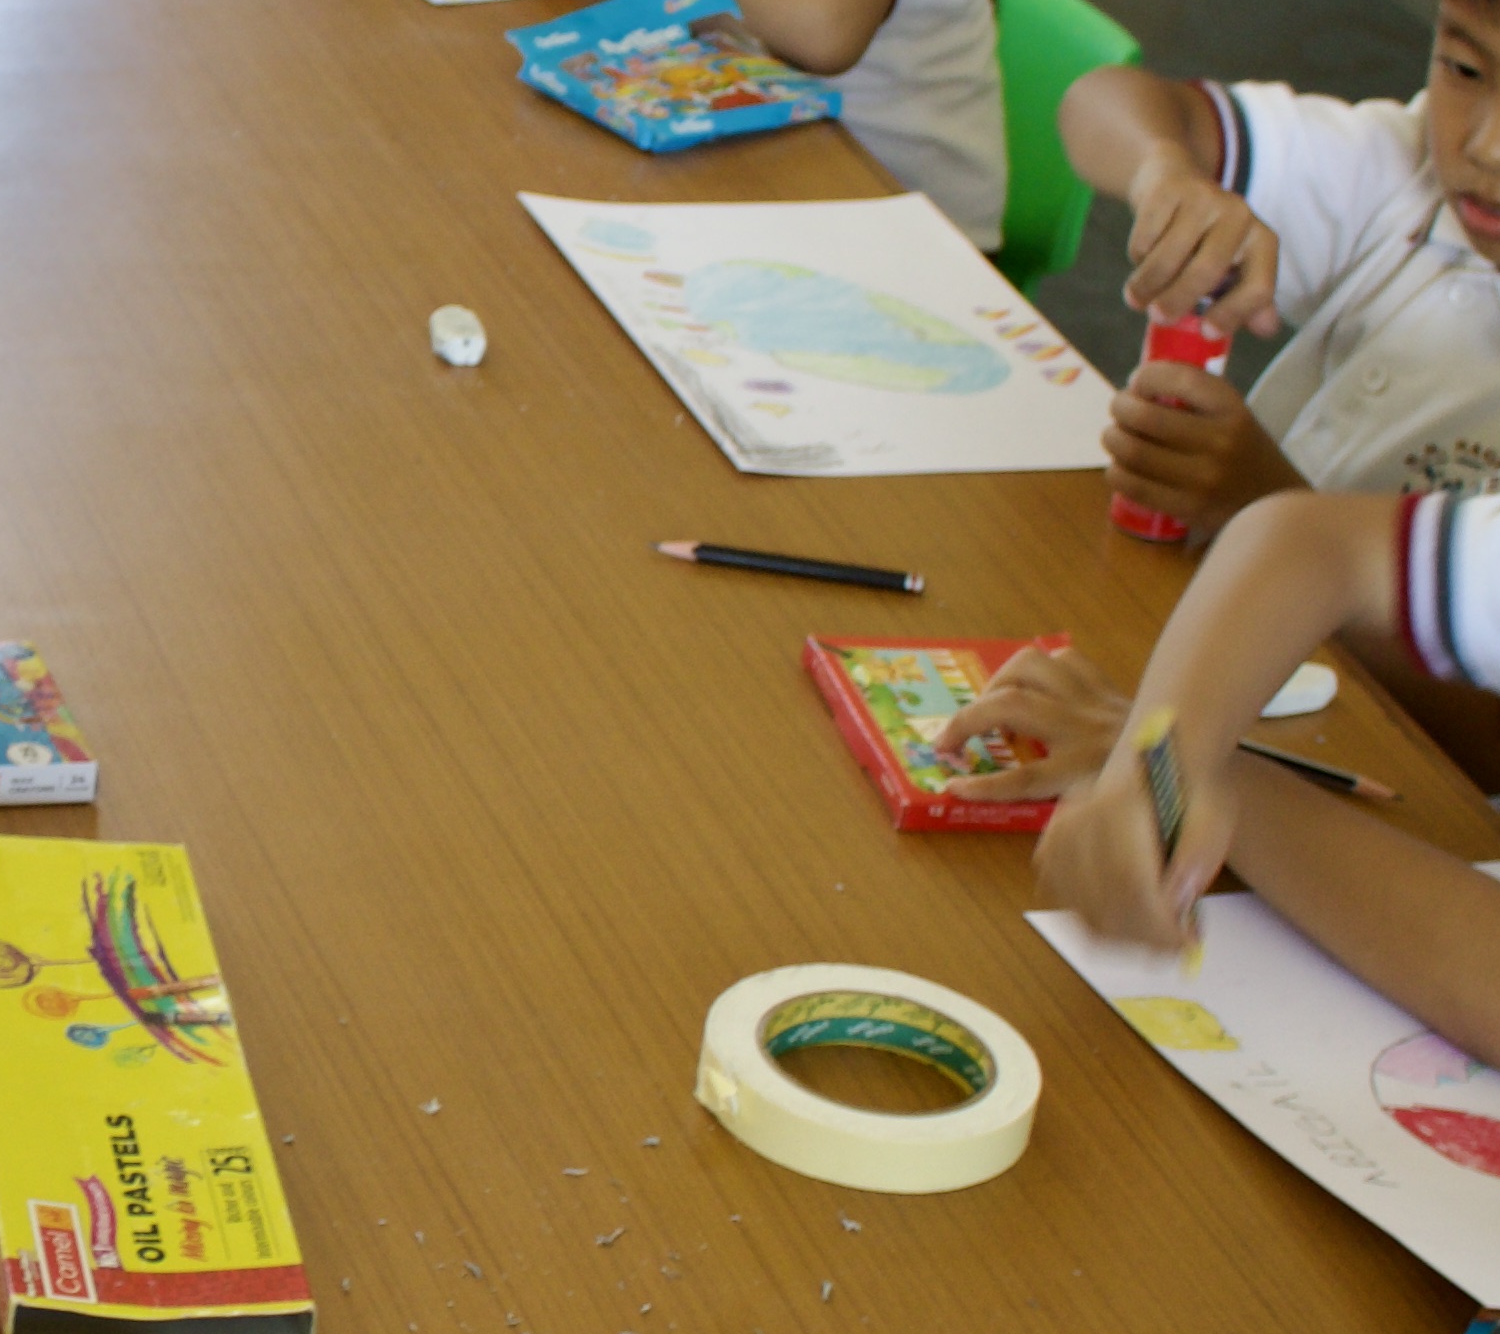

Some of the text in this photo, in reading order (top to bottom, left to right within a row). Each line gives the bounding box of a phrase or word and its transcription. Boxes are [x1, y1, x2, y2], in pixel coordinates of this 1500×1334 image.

[106, 1114, 166, 1263] OIL PASTELS
[45, 1229, 83, 1295] Camel
